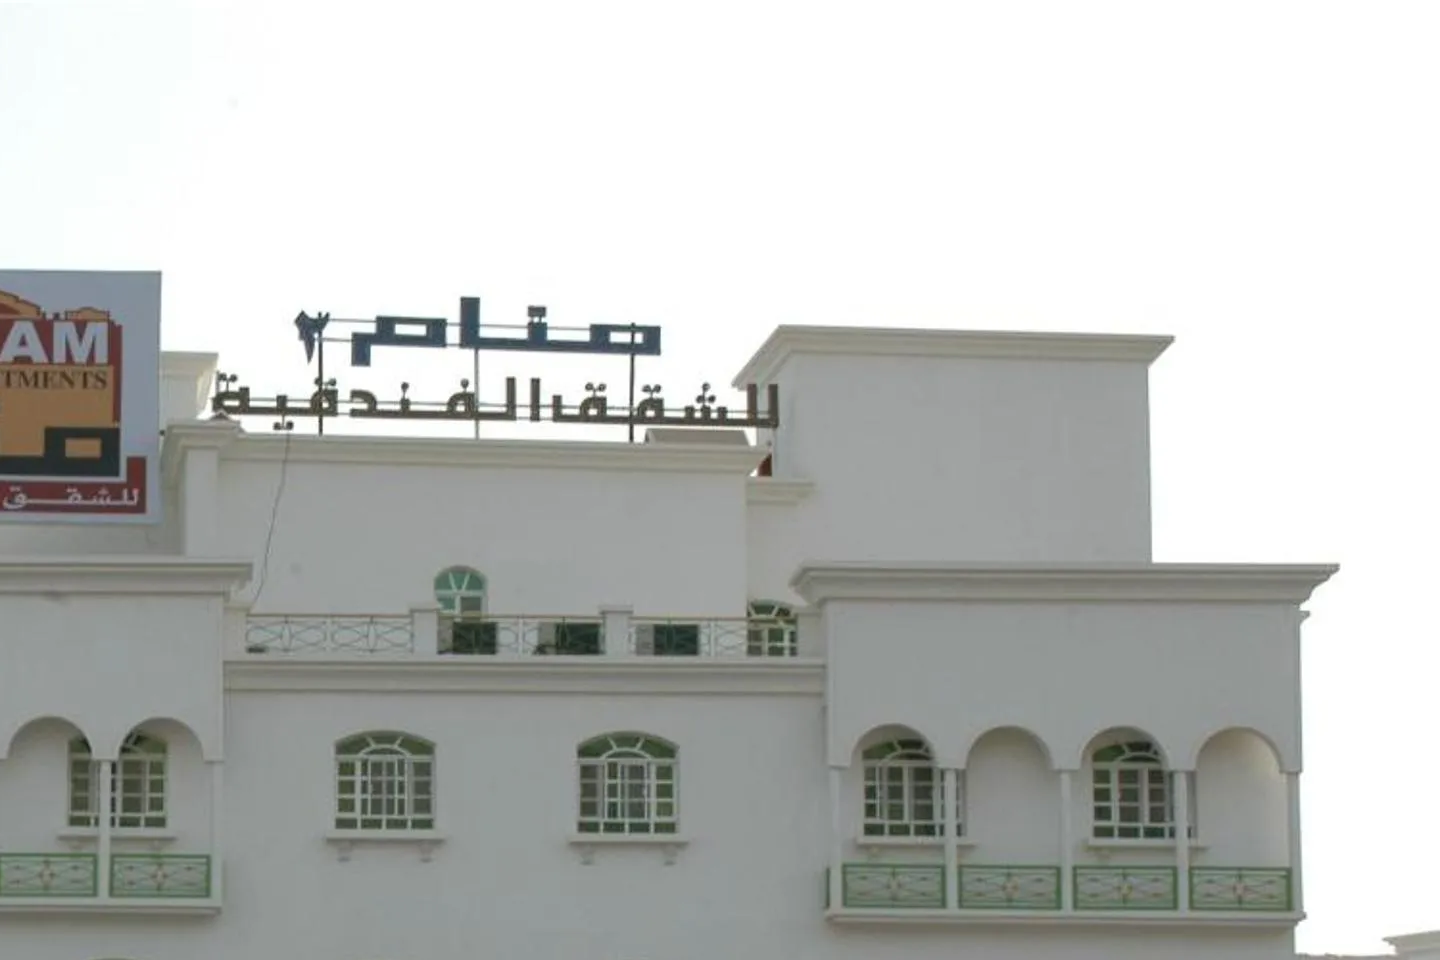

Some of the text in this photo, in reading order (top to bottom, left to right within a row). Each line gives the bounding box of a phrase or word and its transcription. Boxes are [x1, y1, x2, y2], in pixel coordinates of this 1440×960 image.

[351, 297, 661, 368] منام
[211, 372, 779, 432] للشقق الفندقية
[3, 485, 139, 510] للشقق
